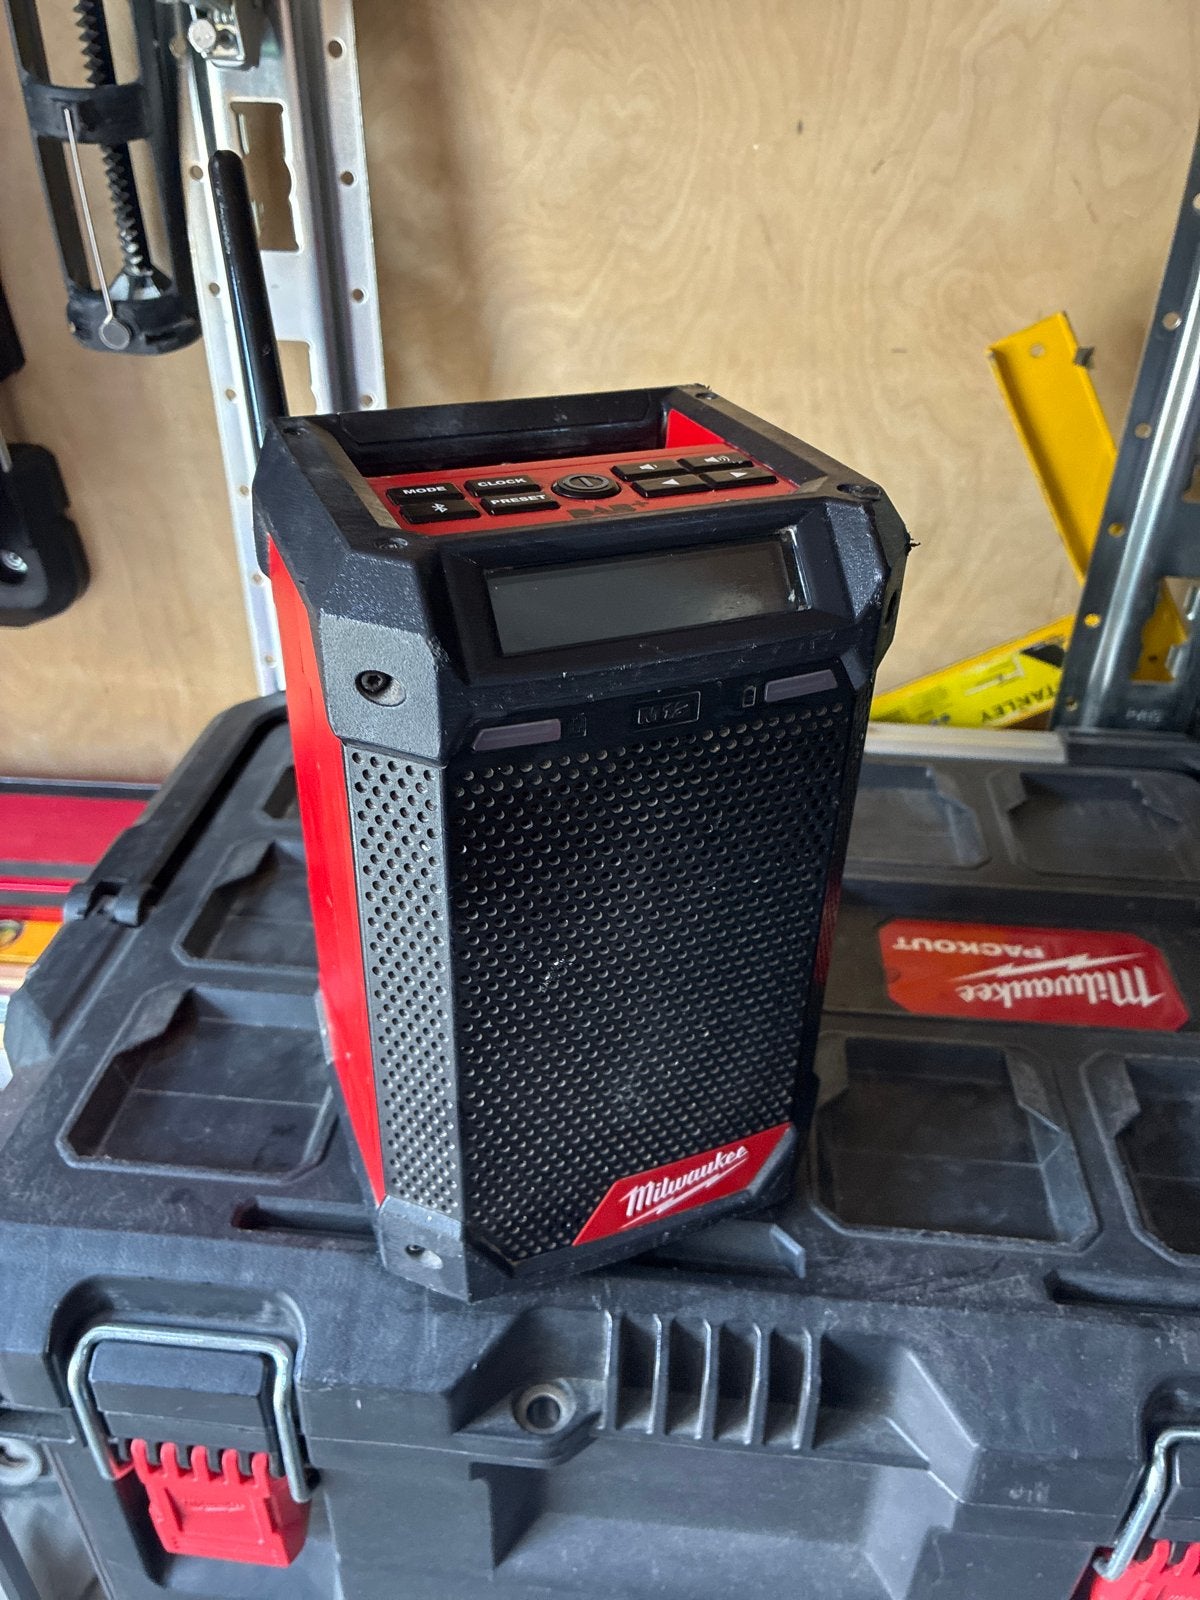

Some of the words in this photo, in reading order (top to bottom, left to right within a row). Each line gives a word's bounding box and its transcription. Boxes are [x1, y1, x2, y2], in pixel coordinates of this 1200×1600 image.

[402, 486, 448, 495] MODE
[477, 477, 527, 487] CLOCK
[490, 494, 546, 505] PRESET
[981, 684, 1056, 722] TANLEY
[893, 936, 1045, 959] PACKOUT
[954, 965, 1166, 1008] Milwaukee
[619, 1146, 749, 1217] Milwaukee
